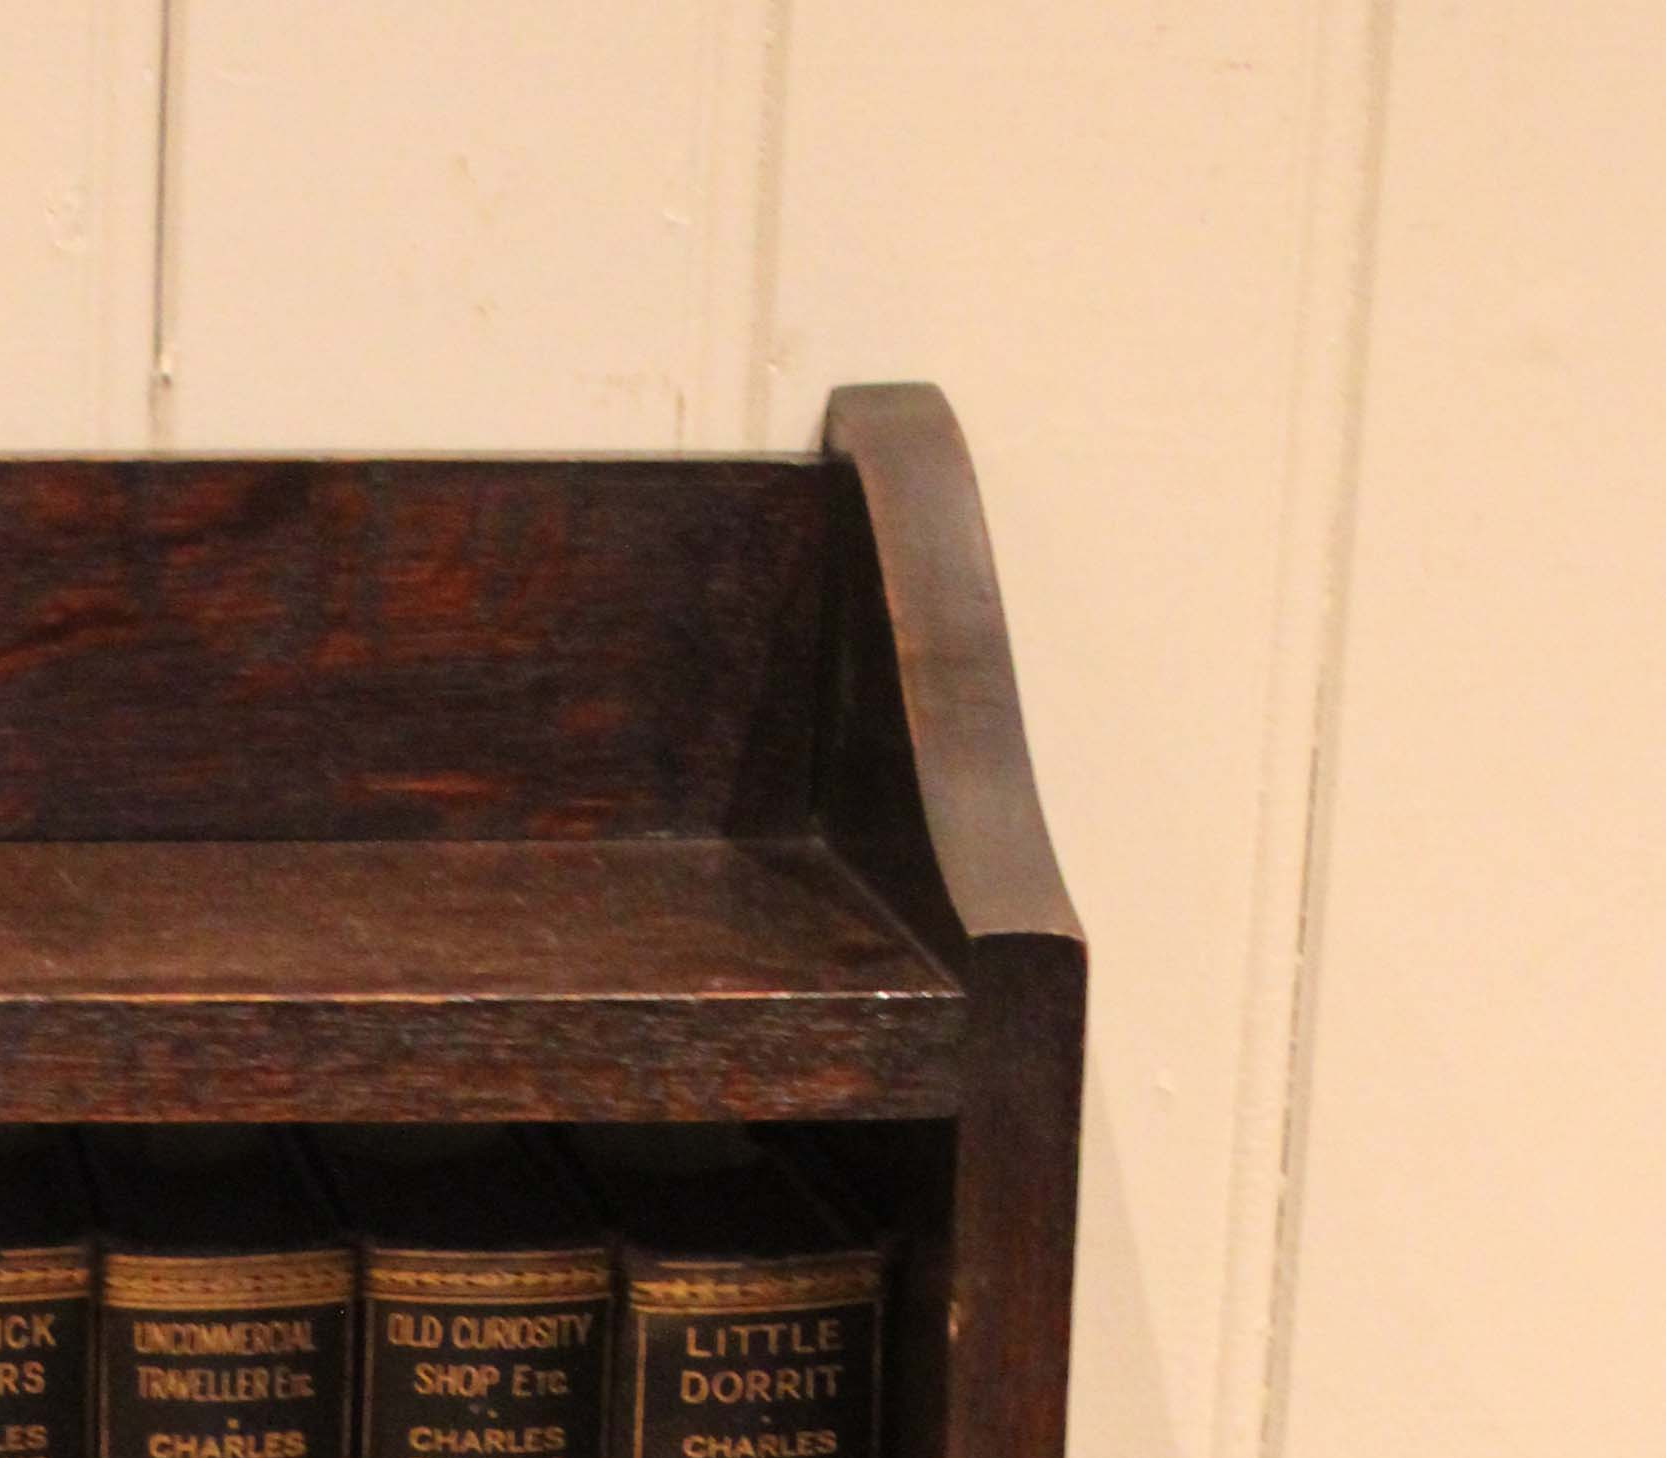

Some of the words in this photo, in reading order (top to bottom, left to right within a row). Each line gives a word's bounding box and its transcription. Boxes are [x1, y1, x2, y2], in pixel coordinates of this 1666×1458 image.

[135, 1321, 314, 1355] UNCOMMERCIAL
[387, 1317, 442, 1349] OLD
[453, 1314, 592, 1348] CURIOSITY
[686, 1321, 841, 1358] LITTLE
[137, 1368, 268, 1400] TRAVELLER
[414, 1364, 500, 1396] SHOP
[681, 1367, 840, 1403] DORRIT
[409, 1427, 565, 1454] CHARLES
